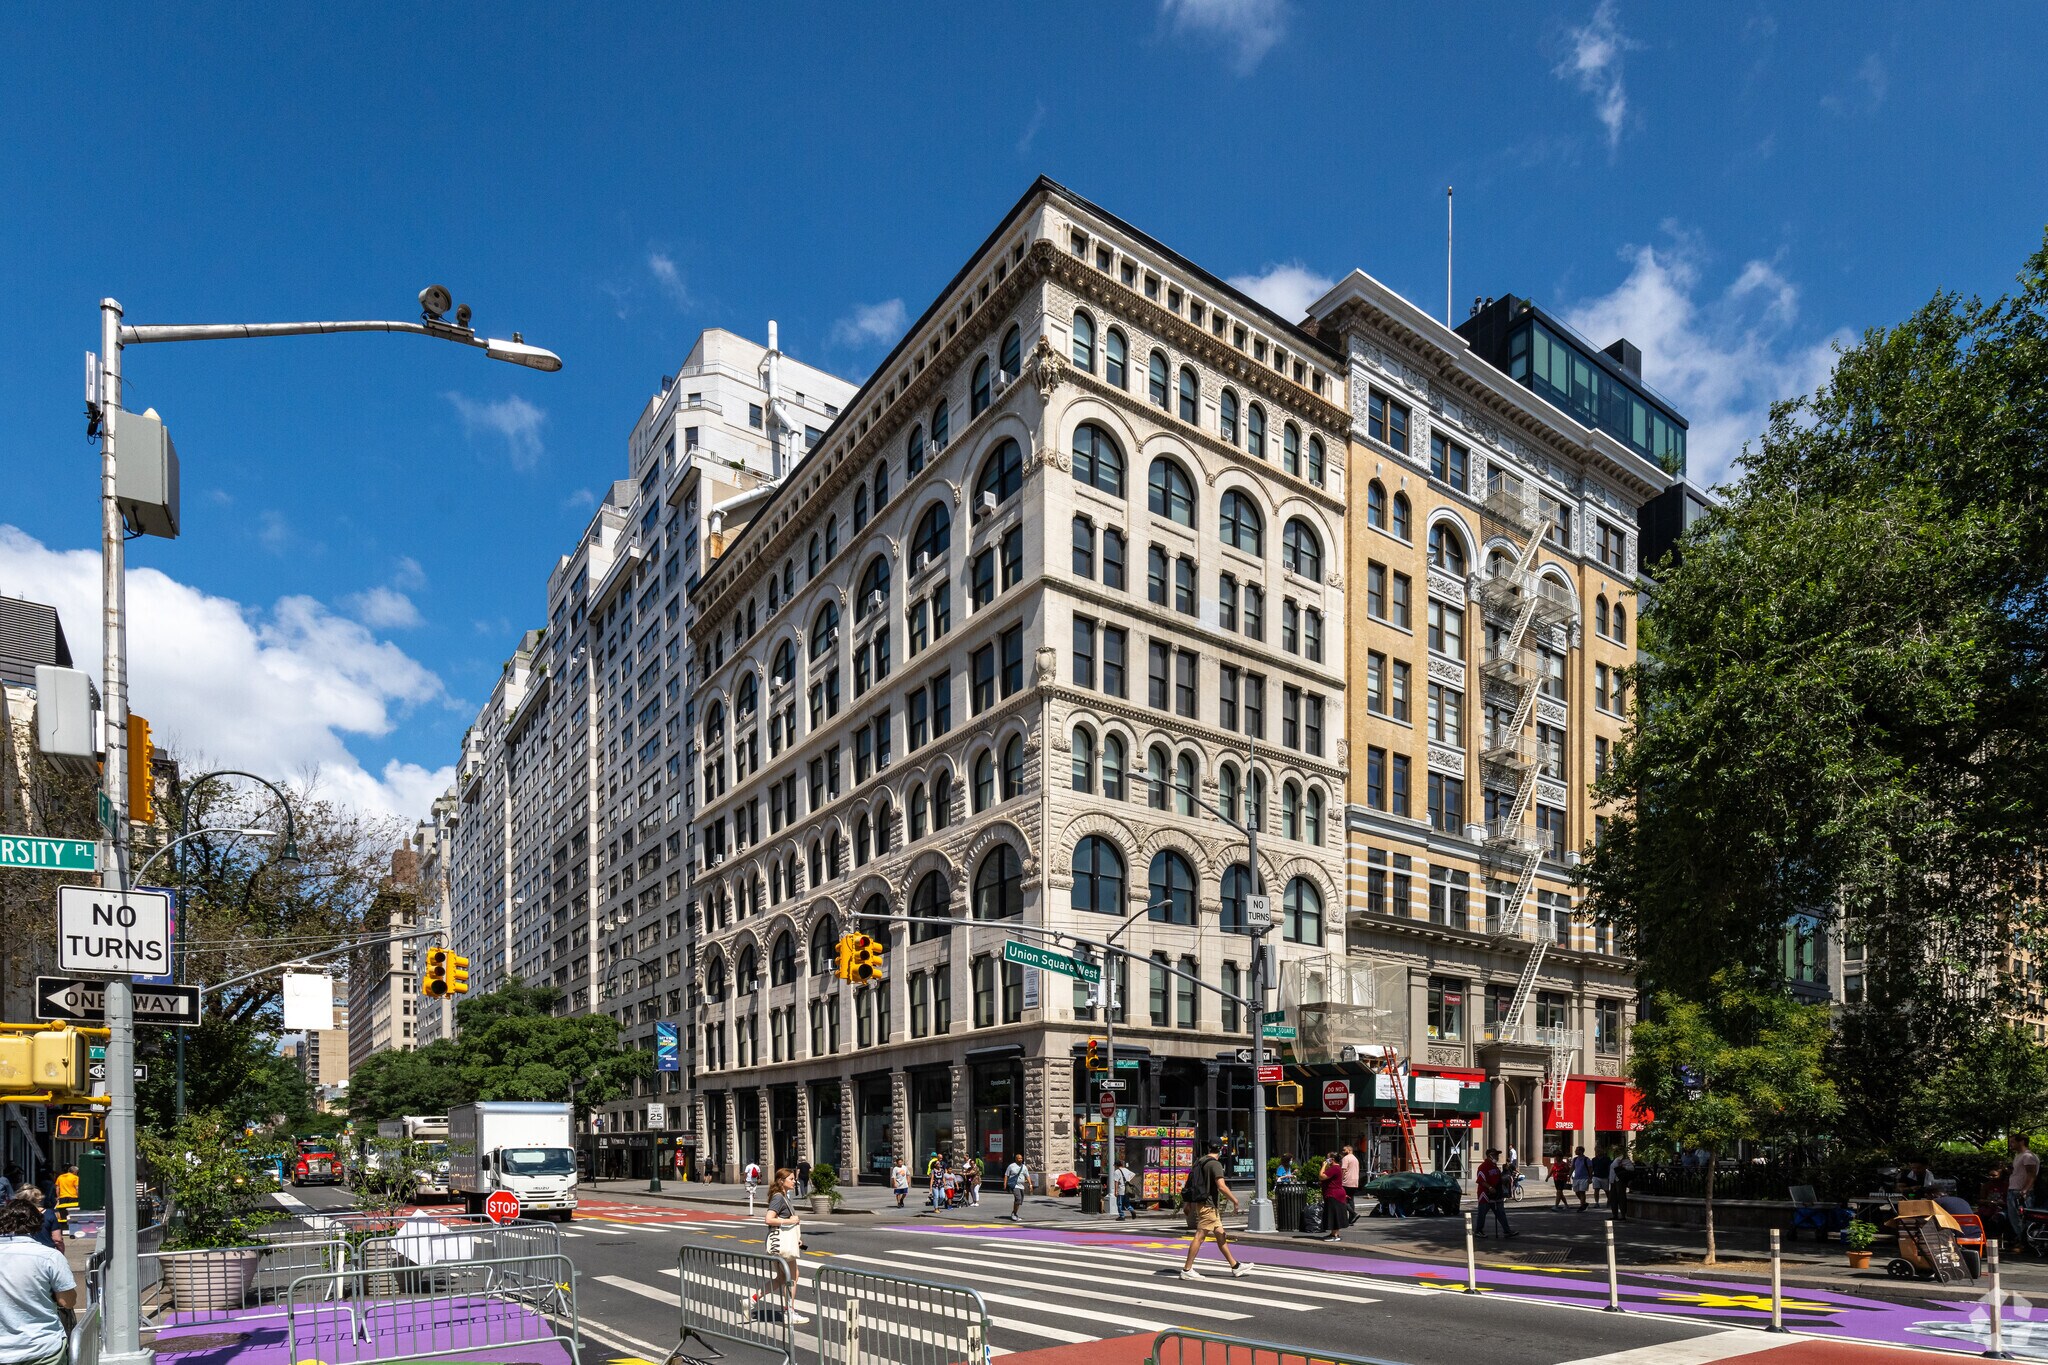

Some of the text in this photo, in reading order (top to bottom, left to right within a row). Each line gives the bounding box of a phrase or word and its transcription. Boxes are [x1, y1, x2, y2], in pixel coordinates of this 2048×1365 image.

[75, 844, 92, 856] PL
[1253, 900, 1264, 909] NO
[92, 903, 136, 928] NO
[1248, 912, 1270, 922] TURNS
[66, 935, 162, 961] TURNS
[1010, 946, 1098, 980] Union Square West
[64, 992, 180, 1012] ONE WAY
[490, 1201, 518, 1214] STOP
